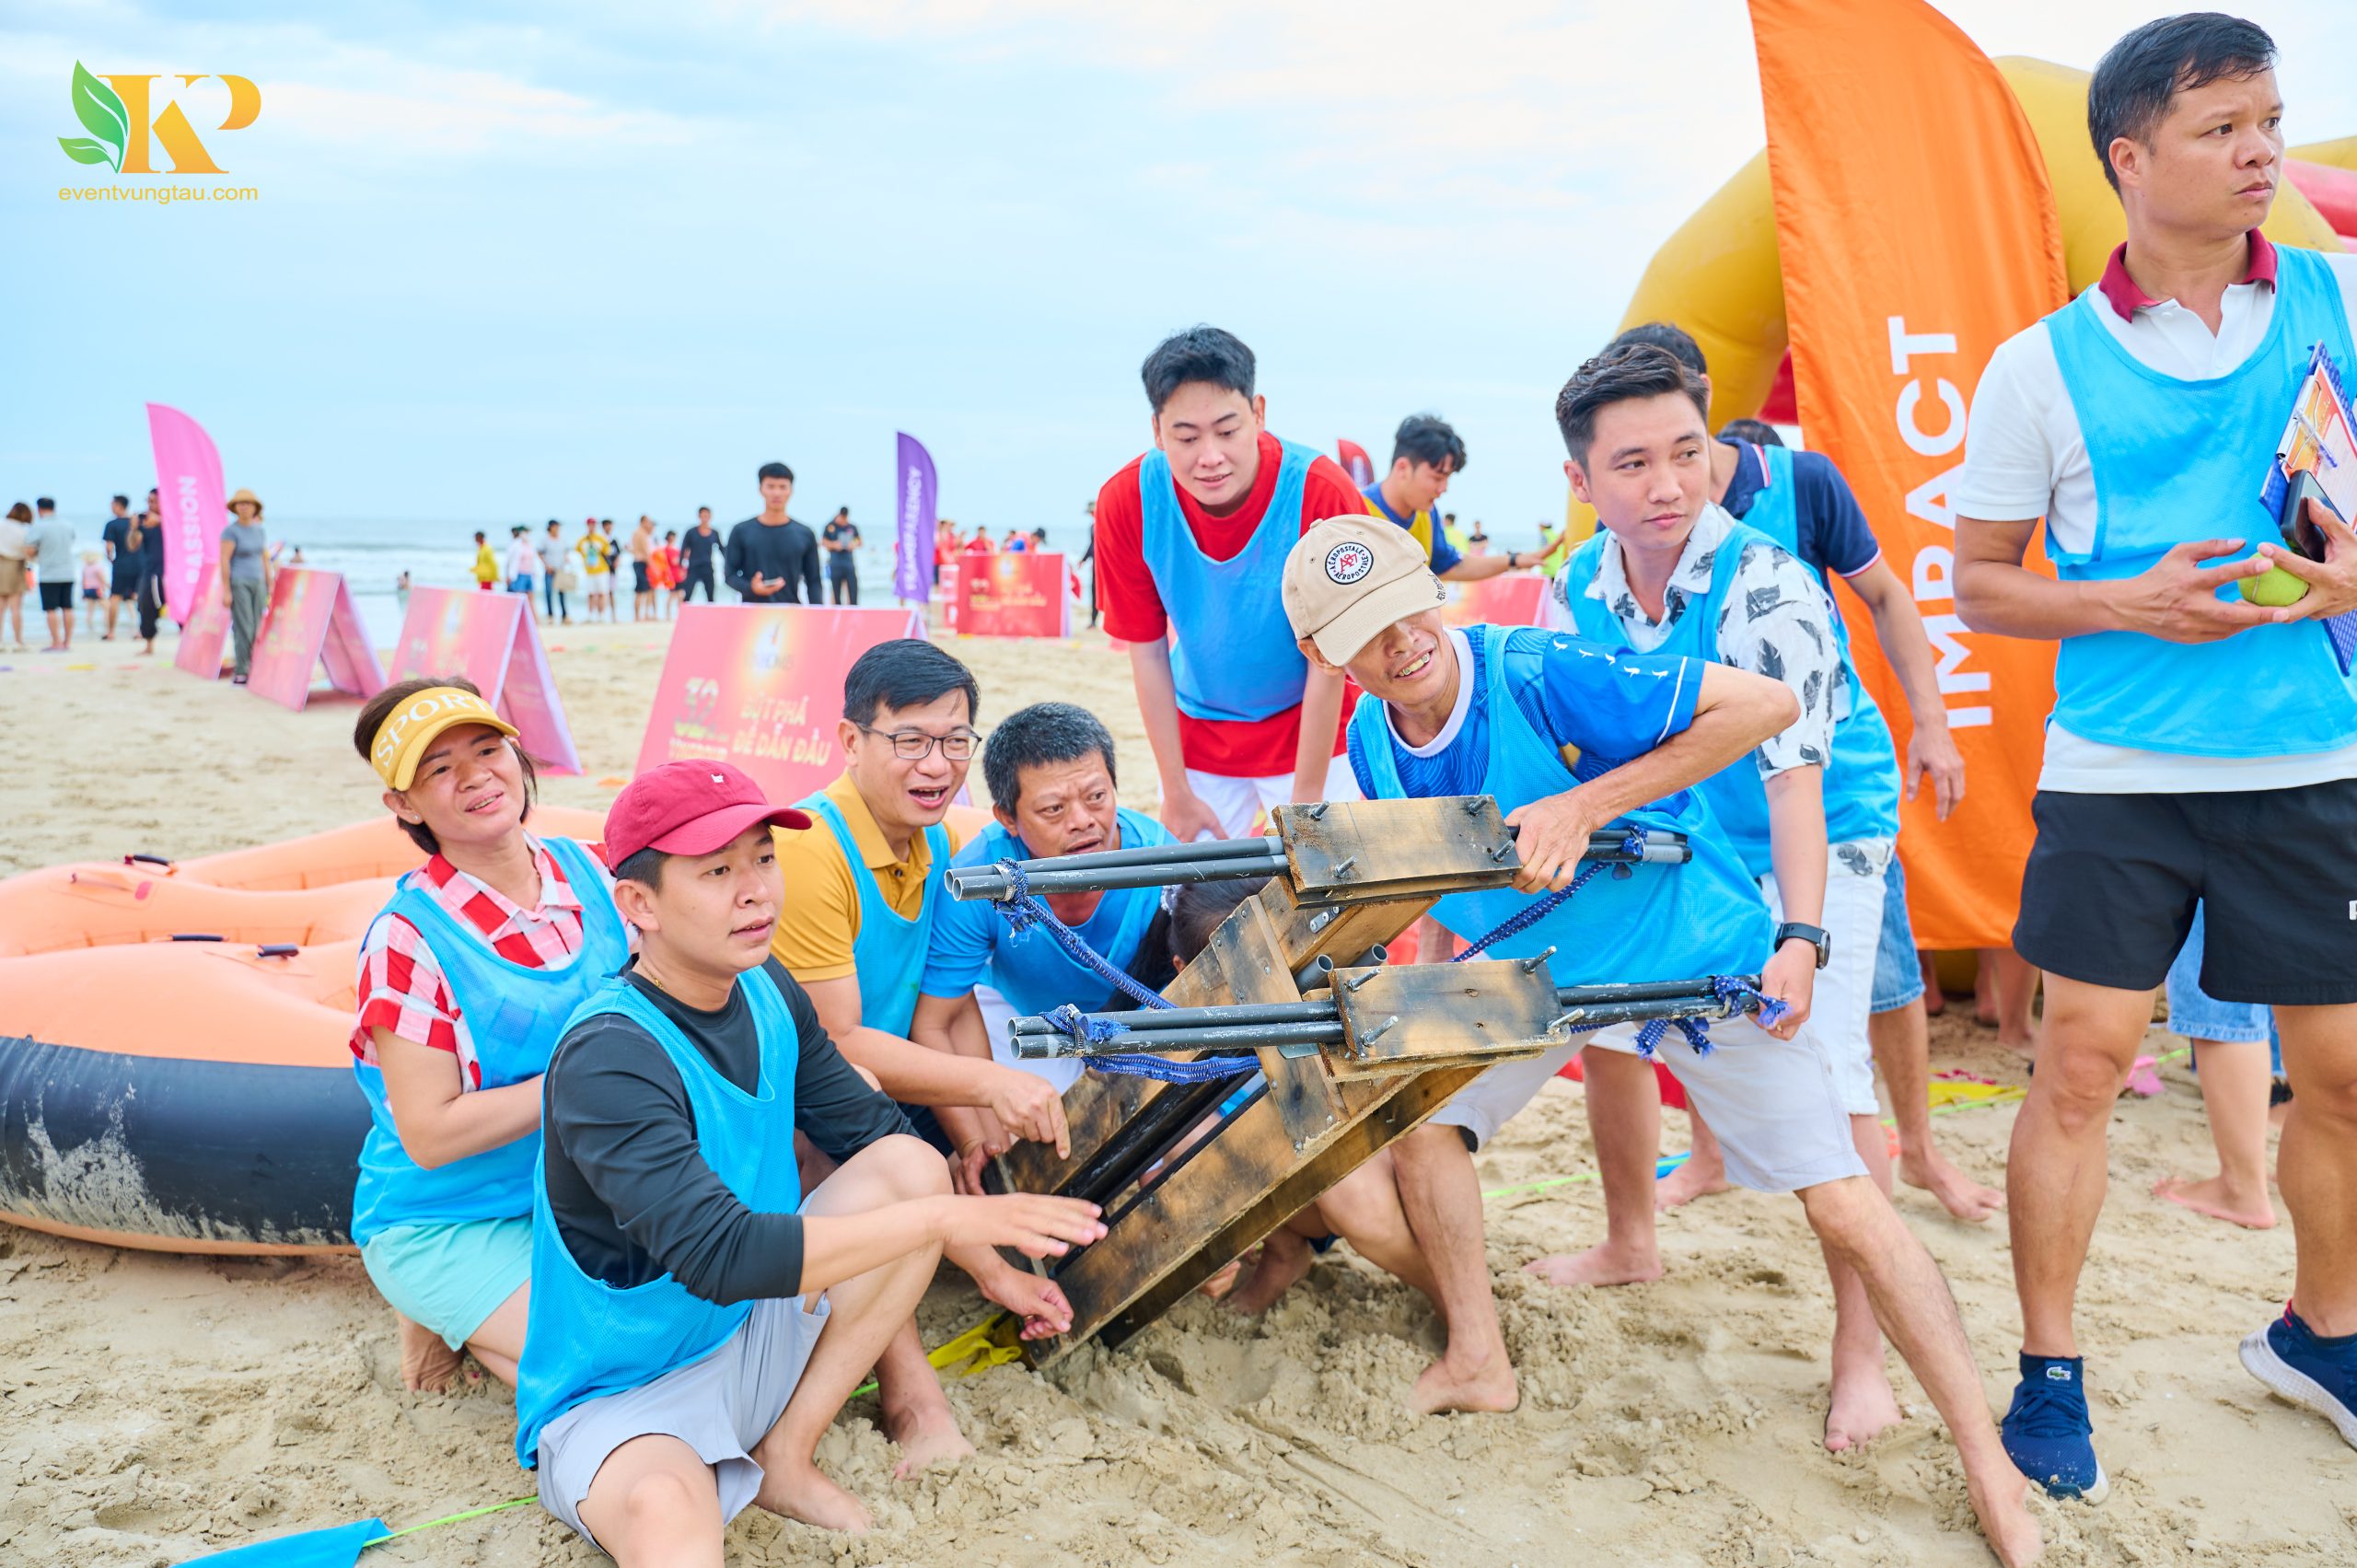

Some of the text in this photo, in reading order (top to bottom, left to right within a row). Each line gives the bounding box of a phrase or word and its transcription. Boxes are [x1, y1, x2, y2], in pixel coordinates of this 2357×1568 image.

[176, 475, 203, 585] PASSION
[1887, 316, 1992, 728] IMPACT
[377, 693, 488, 767] SPORT
